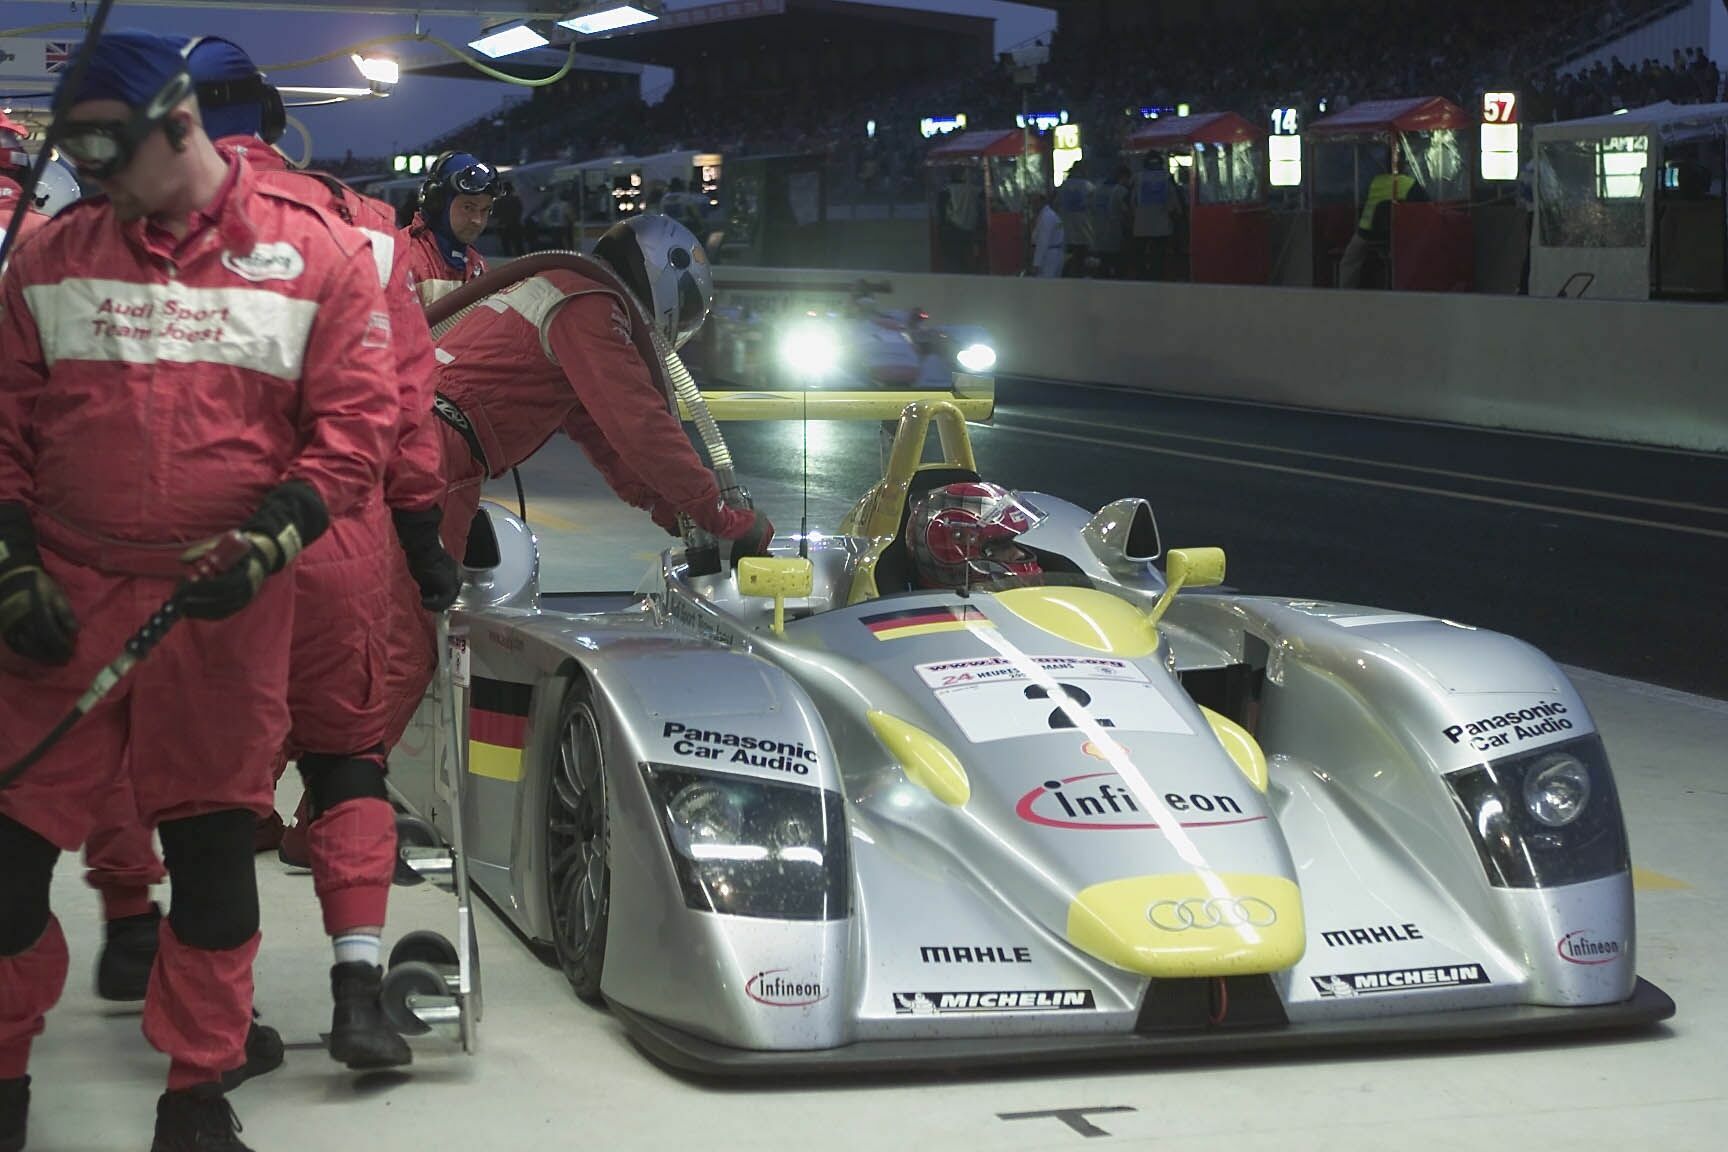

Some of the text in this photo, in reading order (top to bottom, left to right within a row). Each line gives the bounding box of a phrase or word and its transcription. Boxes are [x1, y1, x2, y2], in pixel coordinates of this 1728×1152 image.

[1484, 92, 1516, 122] 57
[1271, 108, 1298, 135] 14
[96, 298, 230, 322] Audi Sport
[91, 319, 225, 343] Team Joest
[942, 662, 1075, 687] 24 HEURES MANS
[1023, 682, 1116, 729] 2
[1442, 700, 1568, 744] Panasonic
[1470, 717, 1574, 752] Car Audio
[663, 721, 820, 764] Panasonic
[673, 739, 809, 777] Car Audio
[1043, 779, 1243, 818] infieon
[1321, 923, 1424, 947] MAHLE
[919, 946, 1033, 963] MAHLE
[1354, 965, 1479, 990] MICHELIN
[940, 991, 1086, 1008] MICHELIN
